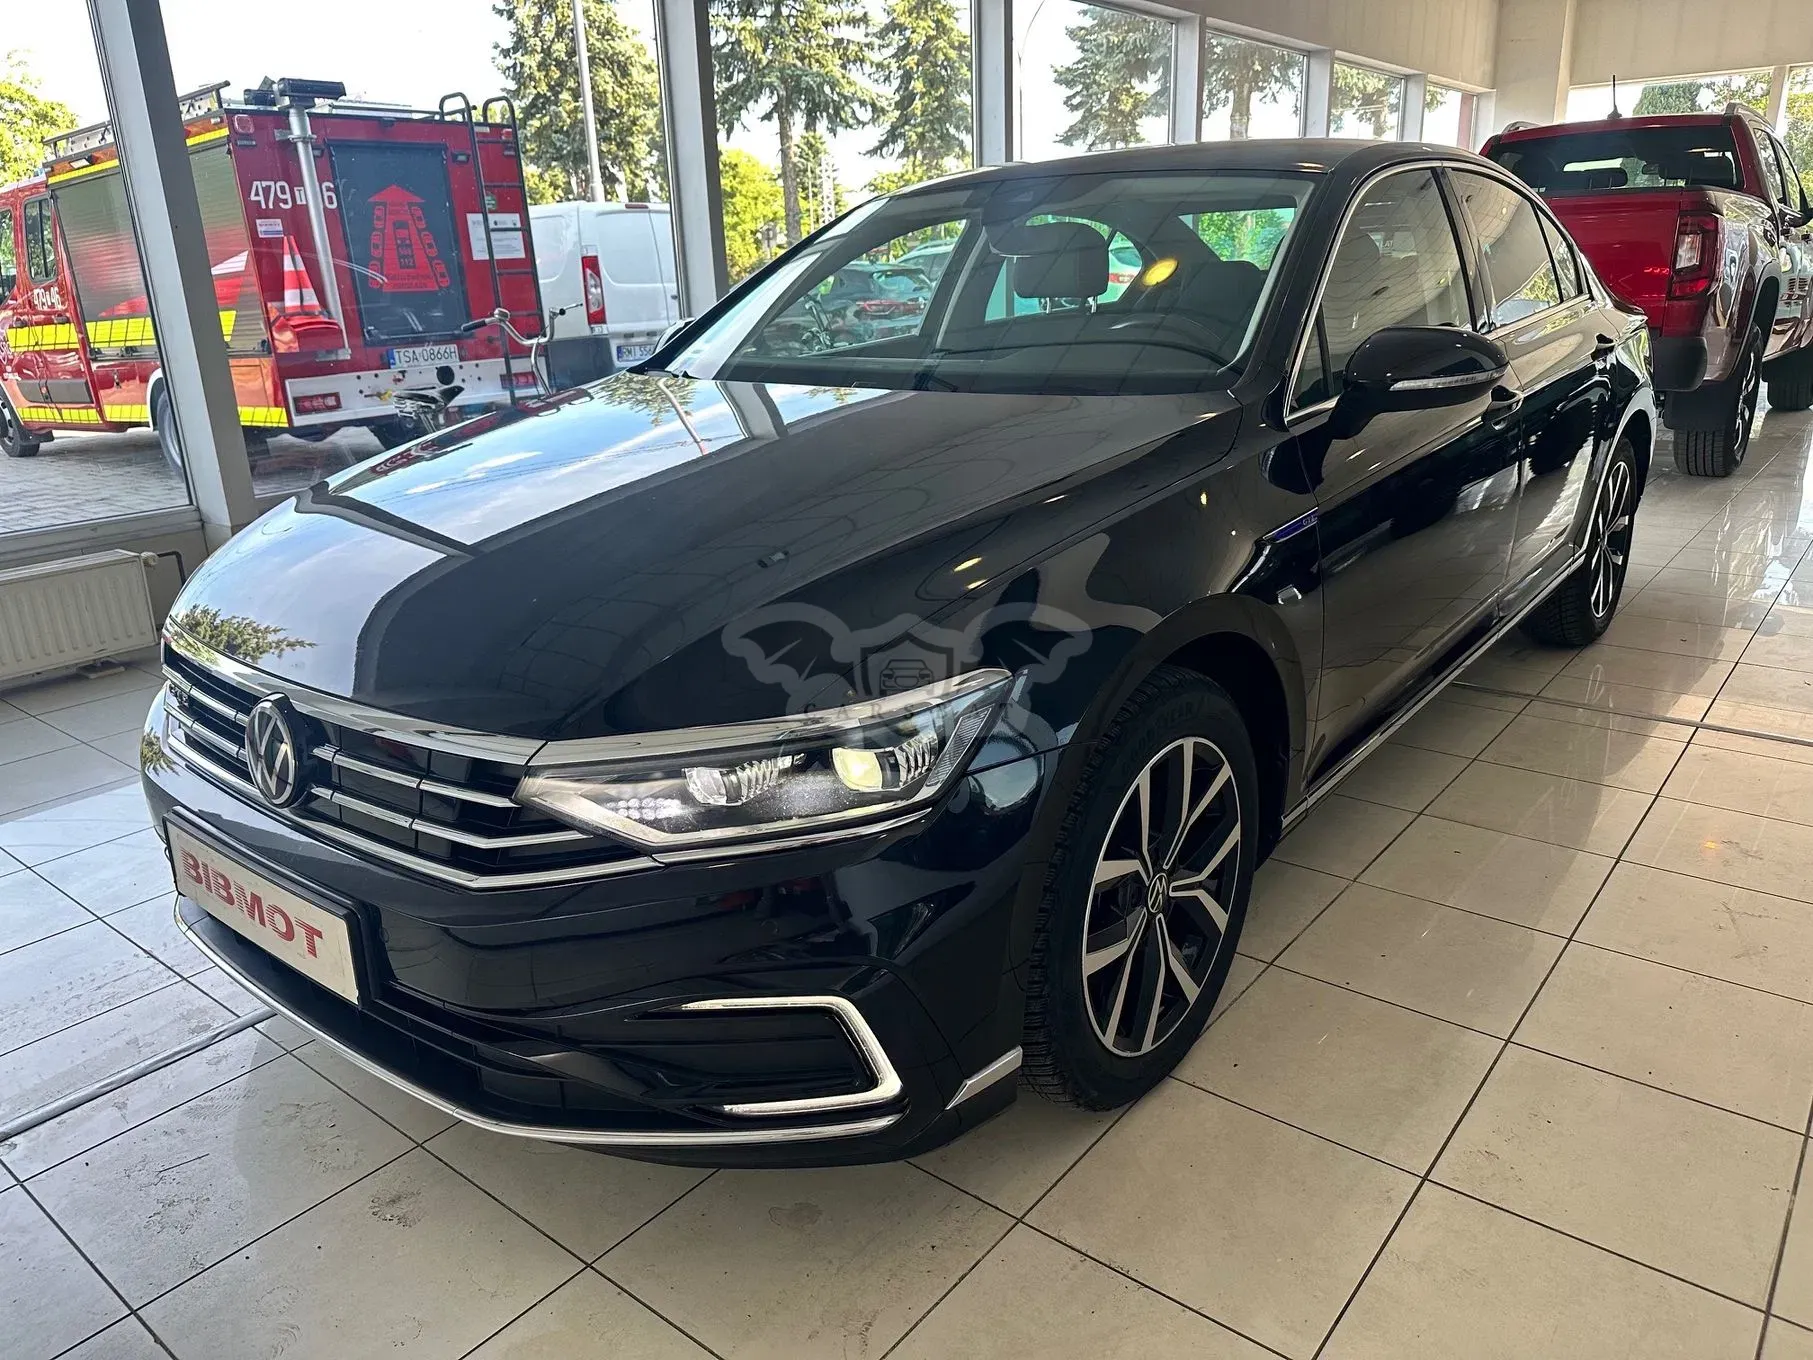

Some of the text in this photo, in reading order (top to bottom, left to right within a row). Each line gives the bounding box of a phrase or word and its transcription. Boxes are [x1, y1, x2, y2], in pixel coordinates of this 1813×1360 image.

[250, 181, 292, 209] 479
[396, 346, 457, 364] TSA 0866H
[181, 846, 324, 960] BIBMOT
